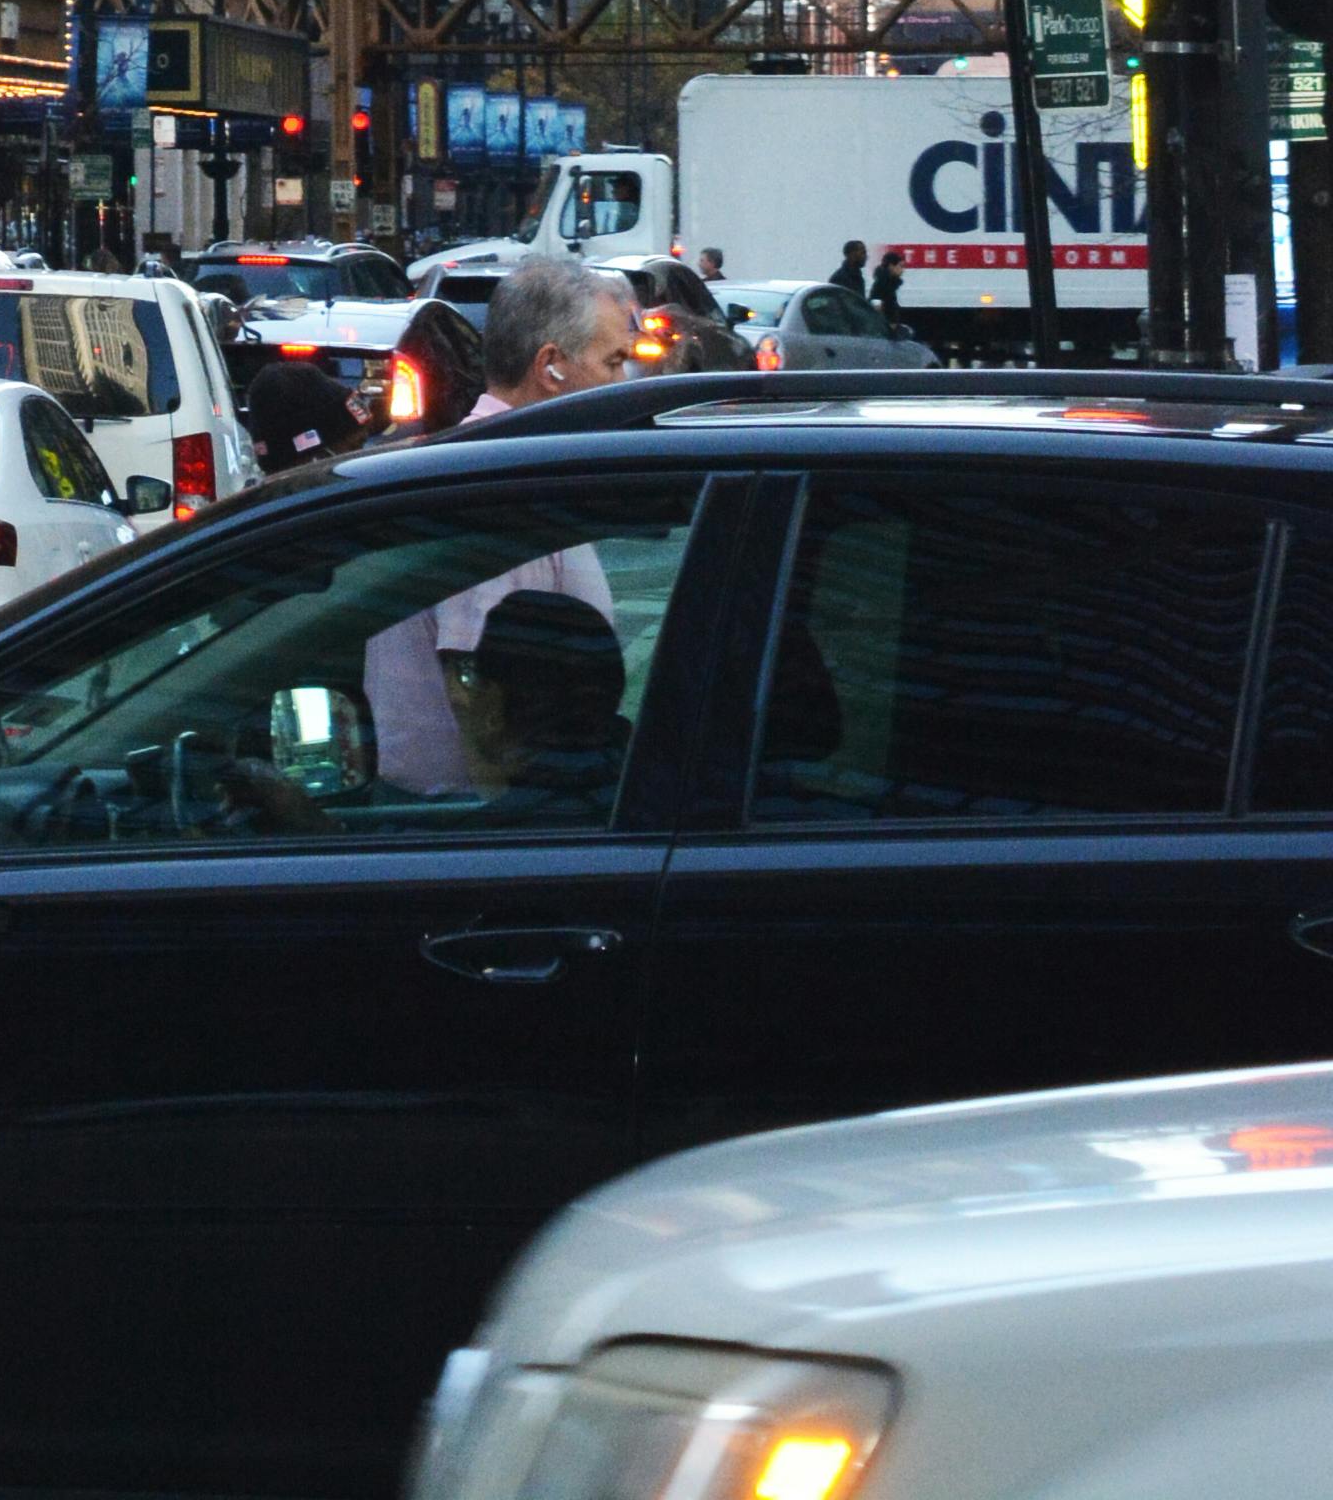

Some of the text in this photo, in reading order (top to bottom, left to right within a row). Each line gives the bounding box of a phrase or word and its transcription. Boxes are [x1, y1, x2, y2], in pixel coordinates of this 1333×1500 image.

[1293, 77, 1323, 91] 521
[903, 249, 1127, 264] THE UNORM
